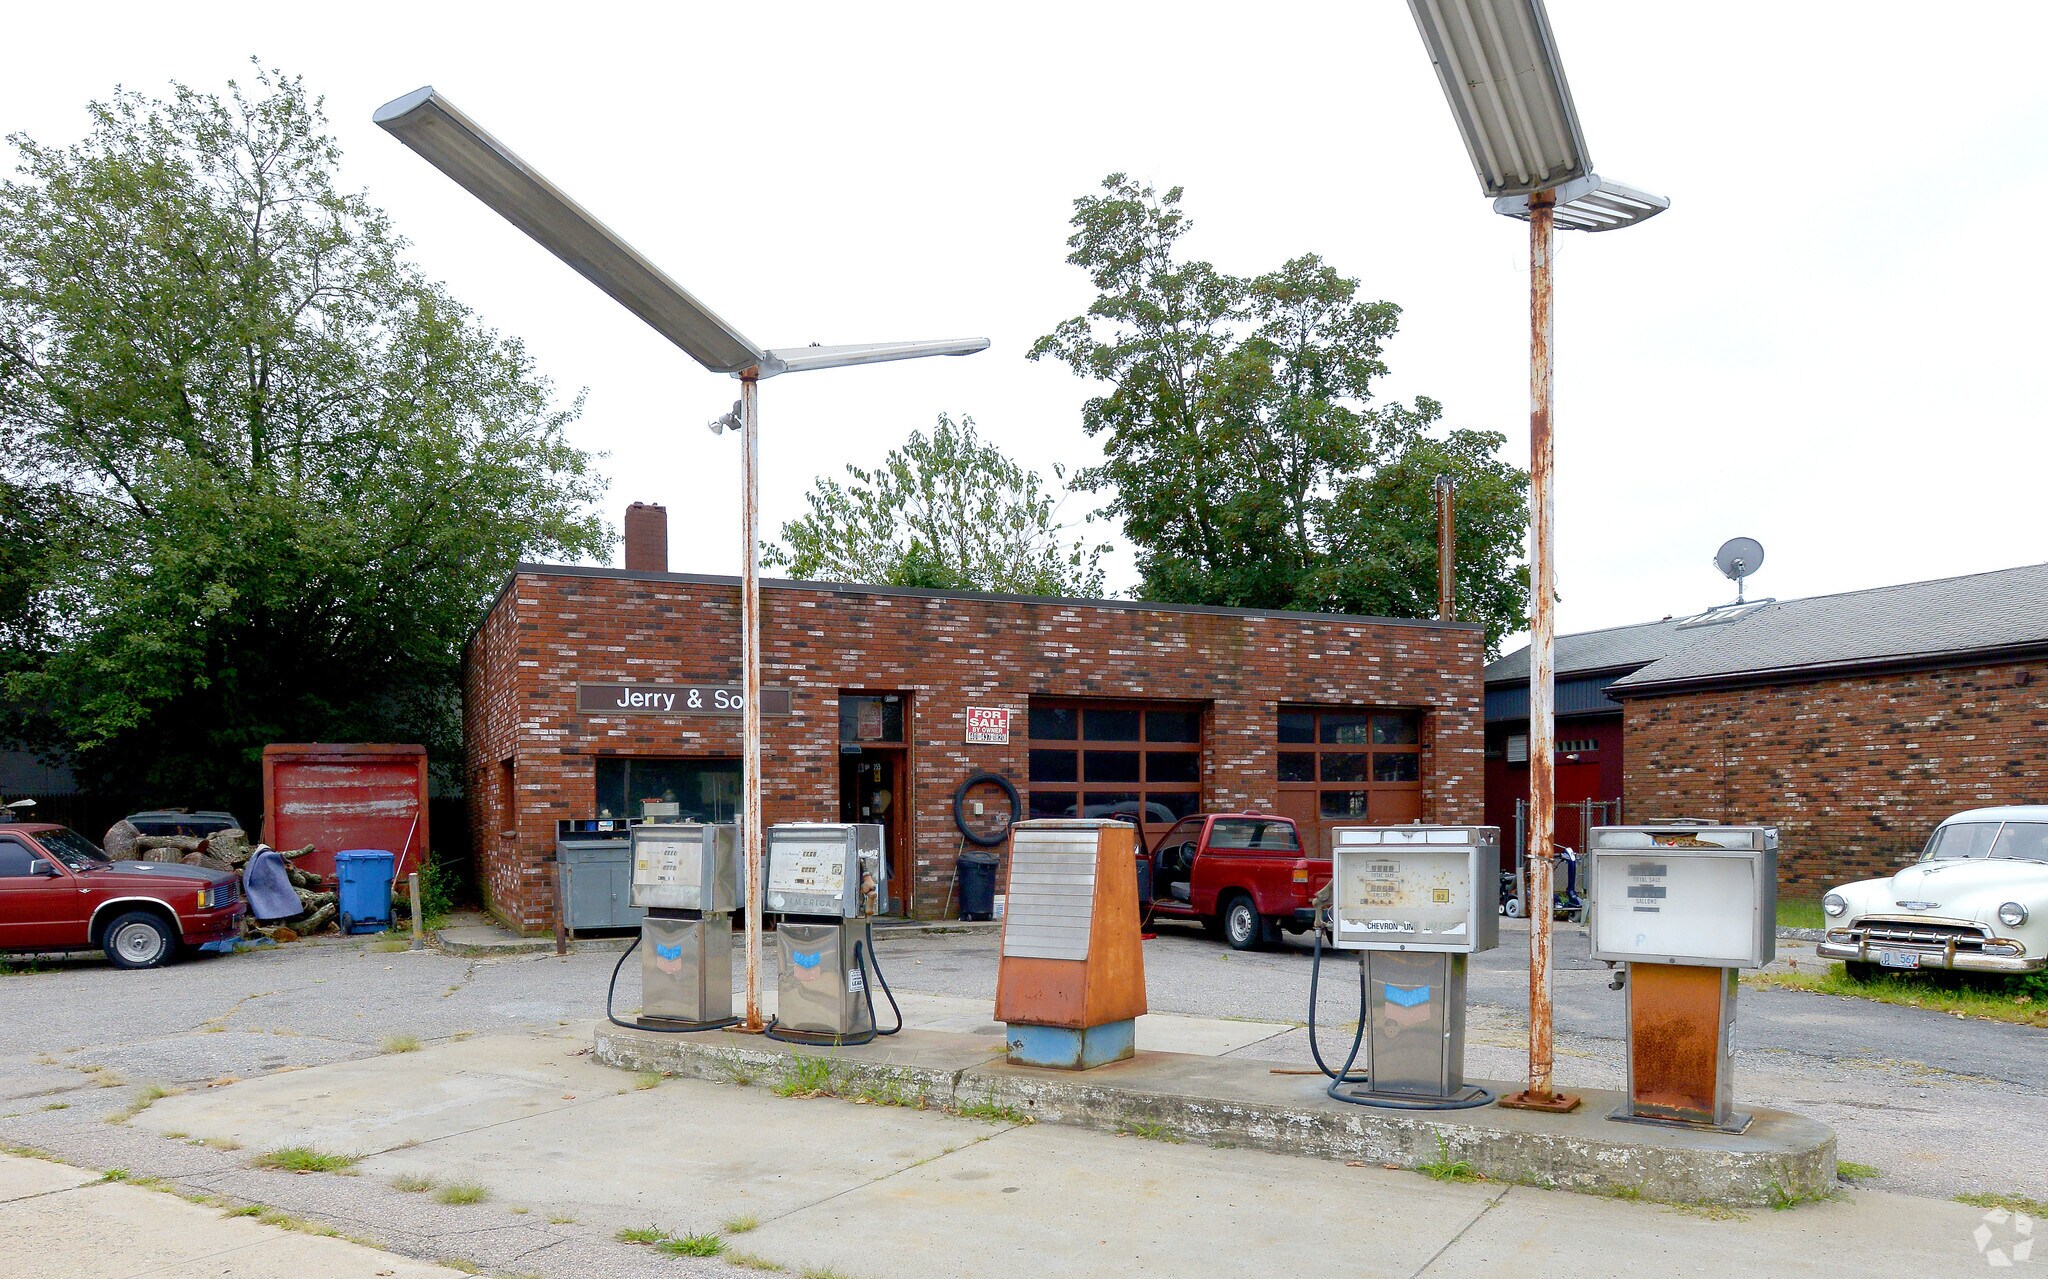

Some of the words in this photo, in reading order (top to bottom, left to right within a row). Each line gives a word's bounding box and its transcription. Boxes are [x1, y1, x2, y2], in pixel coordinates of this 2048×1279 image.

[616, 688, 675, 711] Jerry
[687, 689, 702, 709] &
[714, 689, 744, 710] So
[975, 710, 1001, 718] FOR
[970, 718, 1006, 728] SALE
[1436, 893, 1445, 901] 92
[1367, 922, 1398, 930] CHEVRON
[1900, 953, 1917, 964] 567
